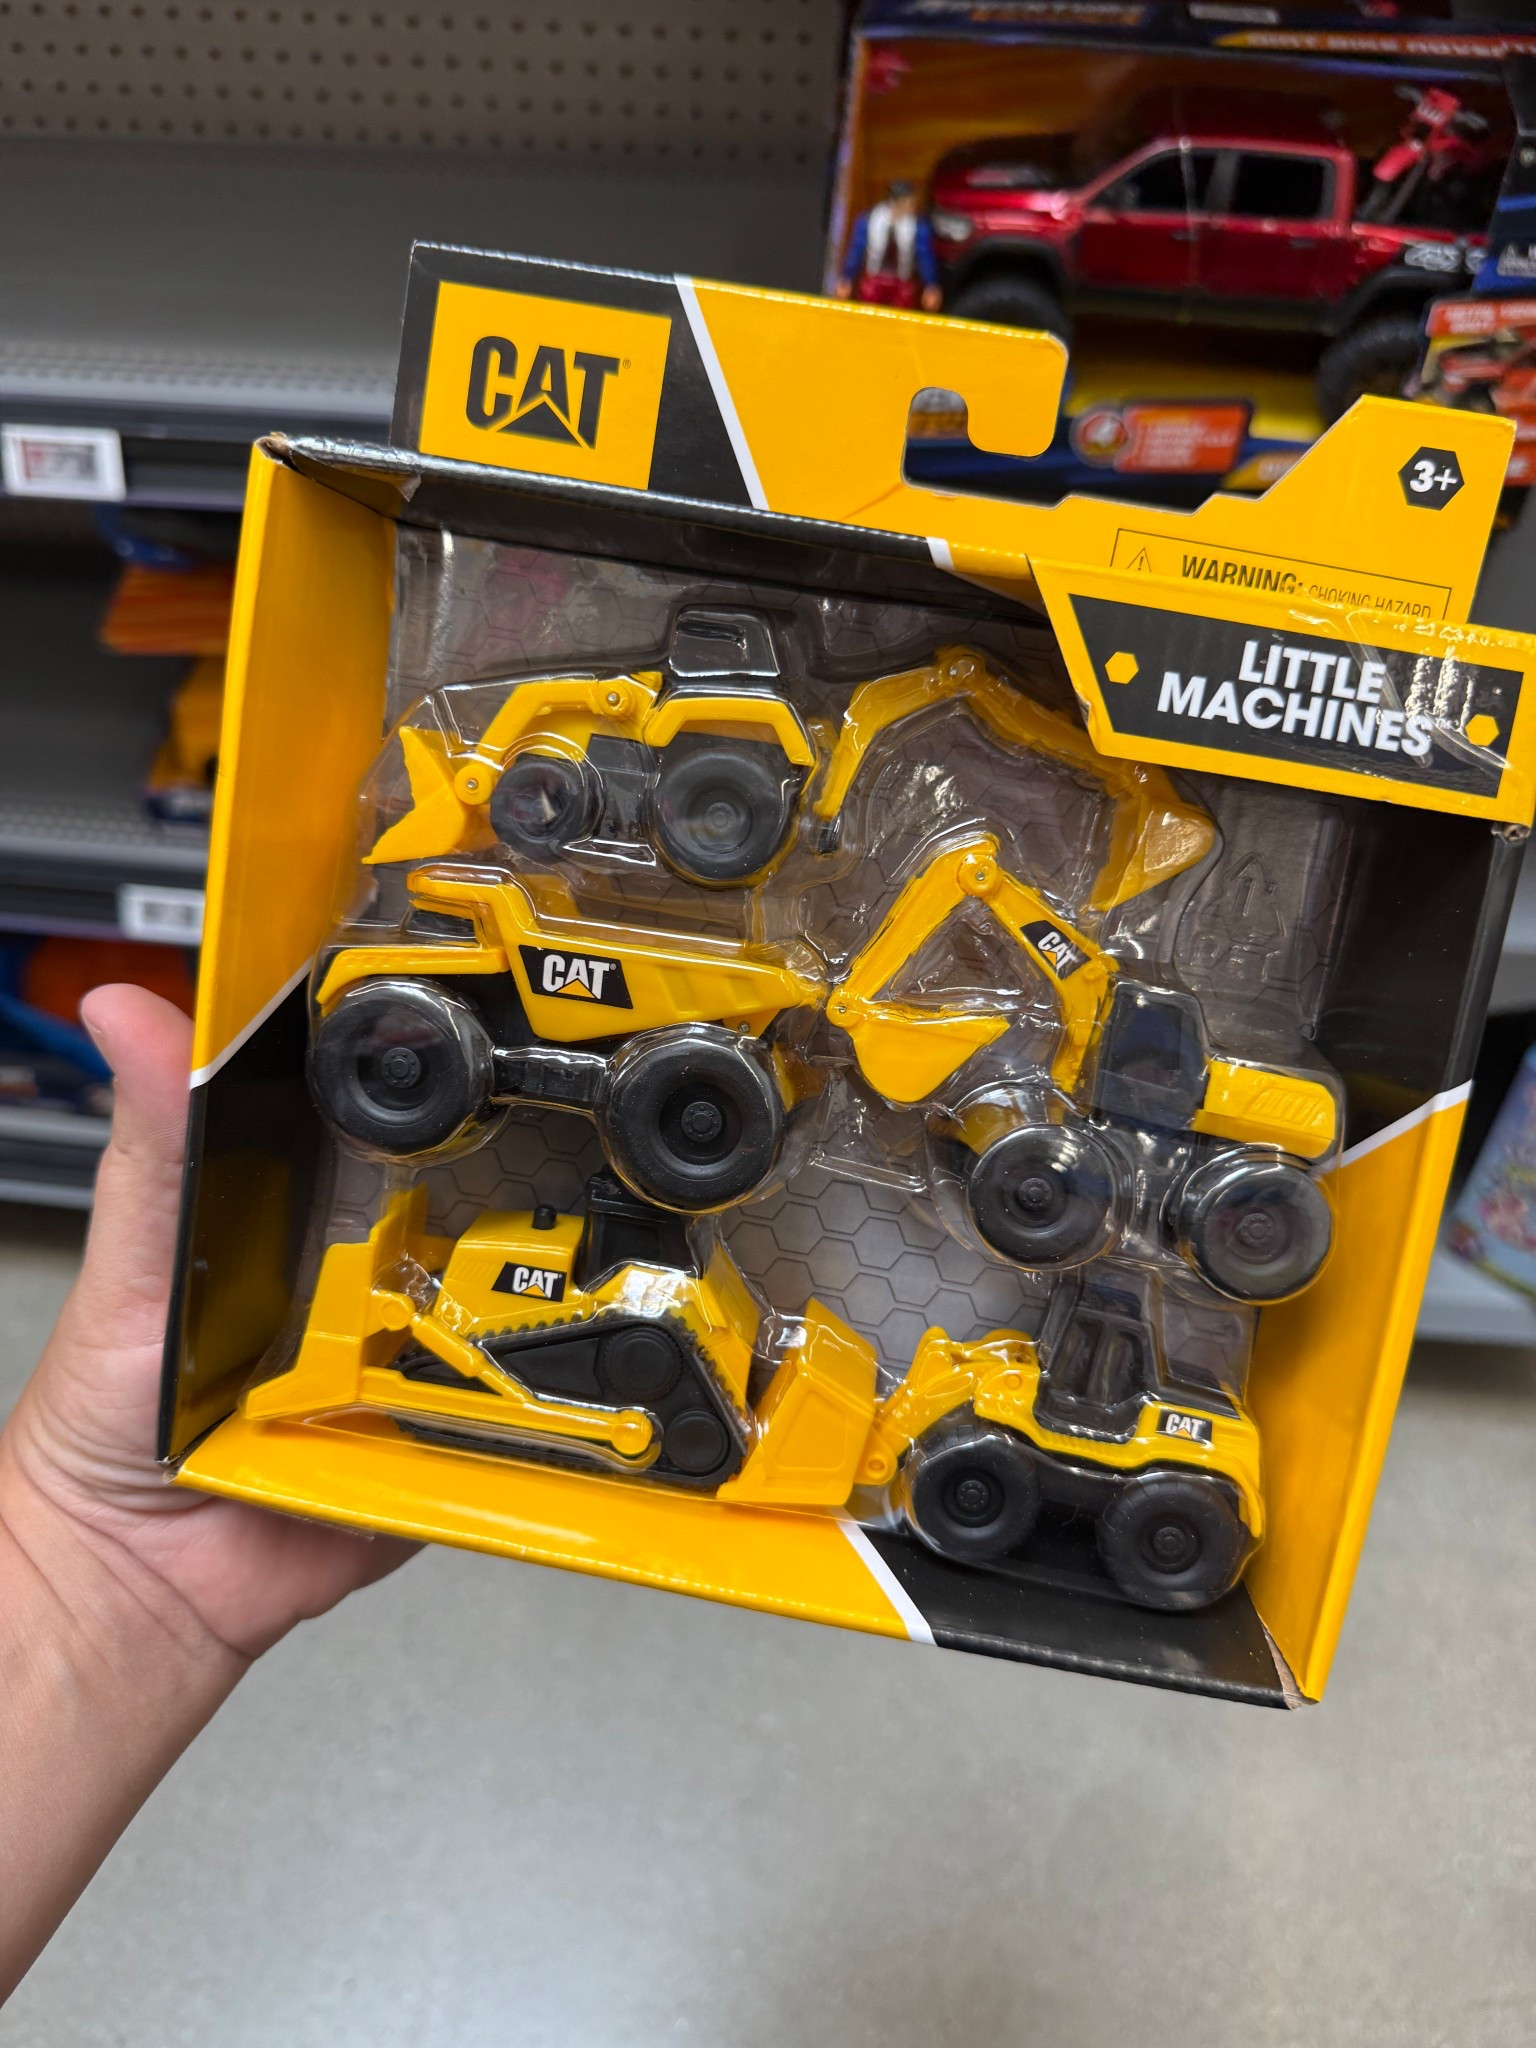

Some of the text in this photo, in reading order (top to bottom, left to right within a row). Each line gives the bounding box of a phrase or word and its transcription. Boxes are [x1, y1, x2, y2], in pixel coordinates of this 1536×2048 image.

[465, 335, 621, 450] CAT
[1409, 460, 1457, 493] 3+
[1238, 639, 1387, 703] LITTLE
[1037, 931, 1079, 970] CAT
[542, 954, 611, 1000] CAT
[512, 1266, 560, 1299] CAT
[1165, 1413, 1203, 1440] CAT
